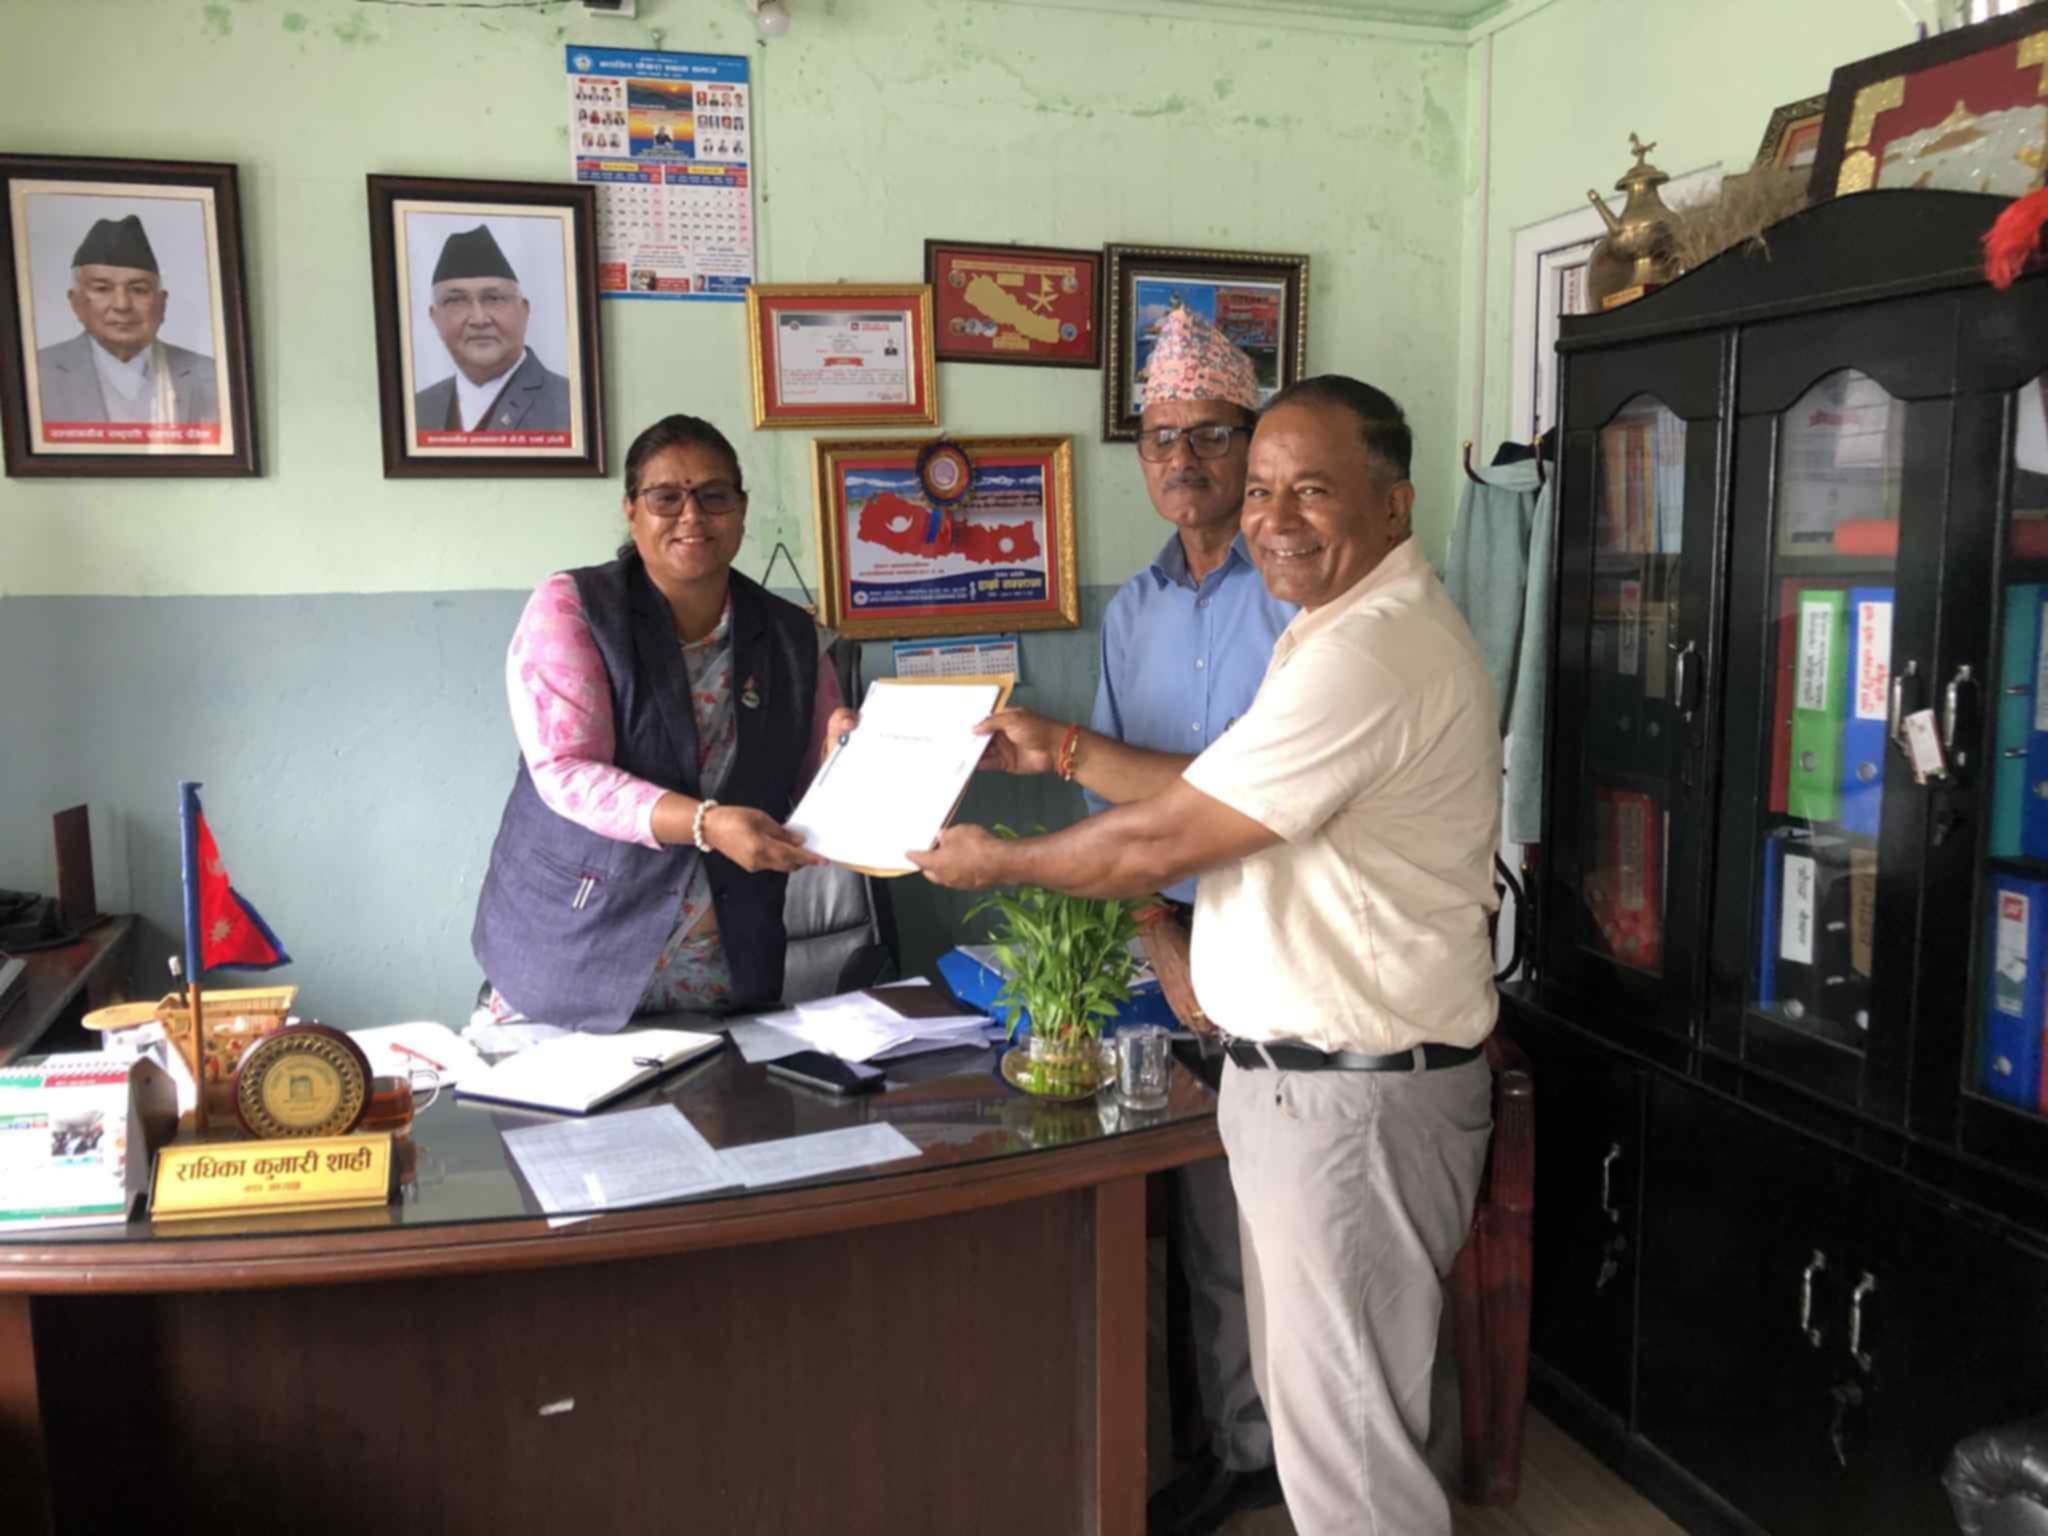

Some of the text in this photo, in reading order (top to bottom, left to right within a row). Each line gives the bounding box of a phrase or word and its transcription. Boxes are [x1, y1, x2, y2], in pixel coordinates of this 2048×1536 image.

[175, 1146, 372, 1182] राधिका कुमारी शाही
